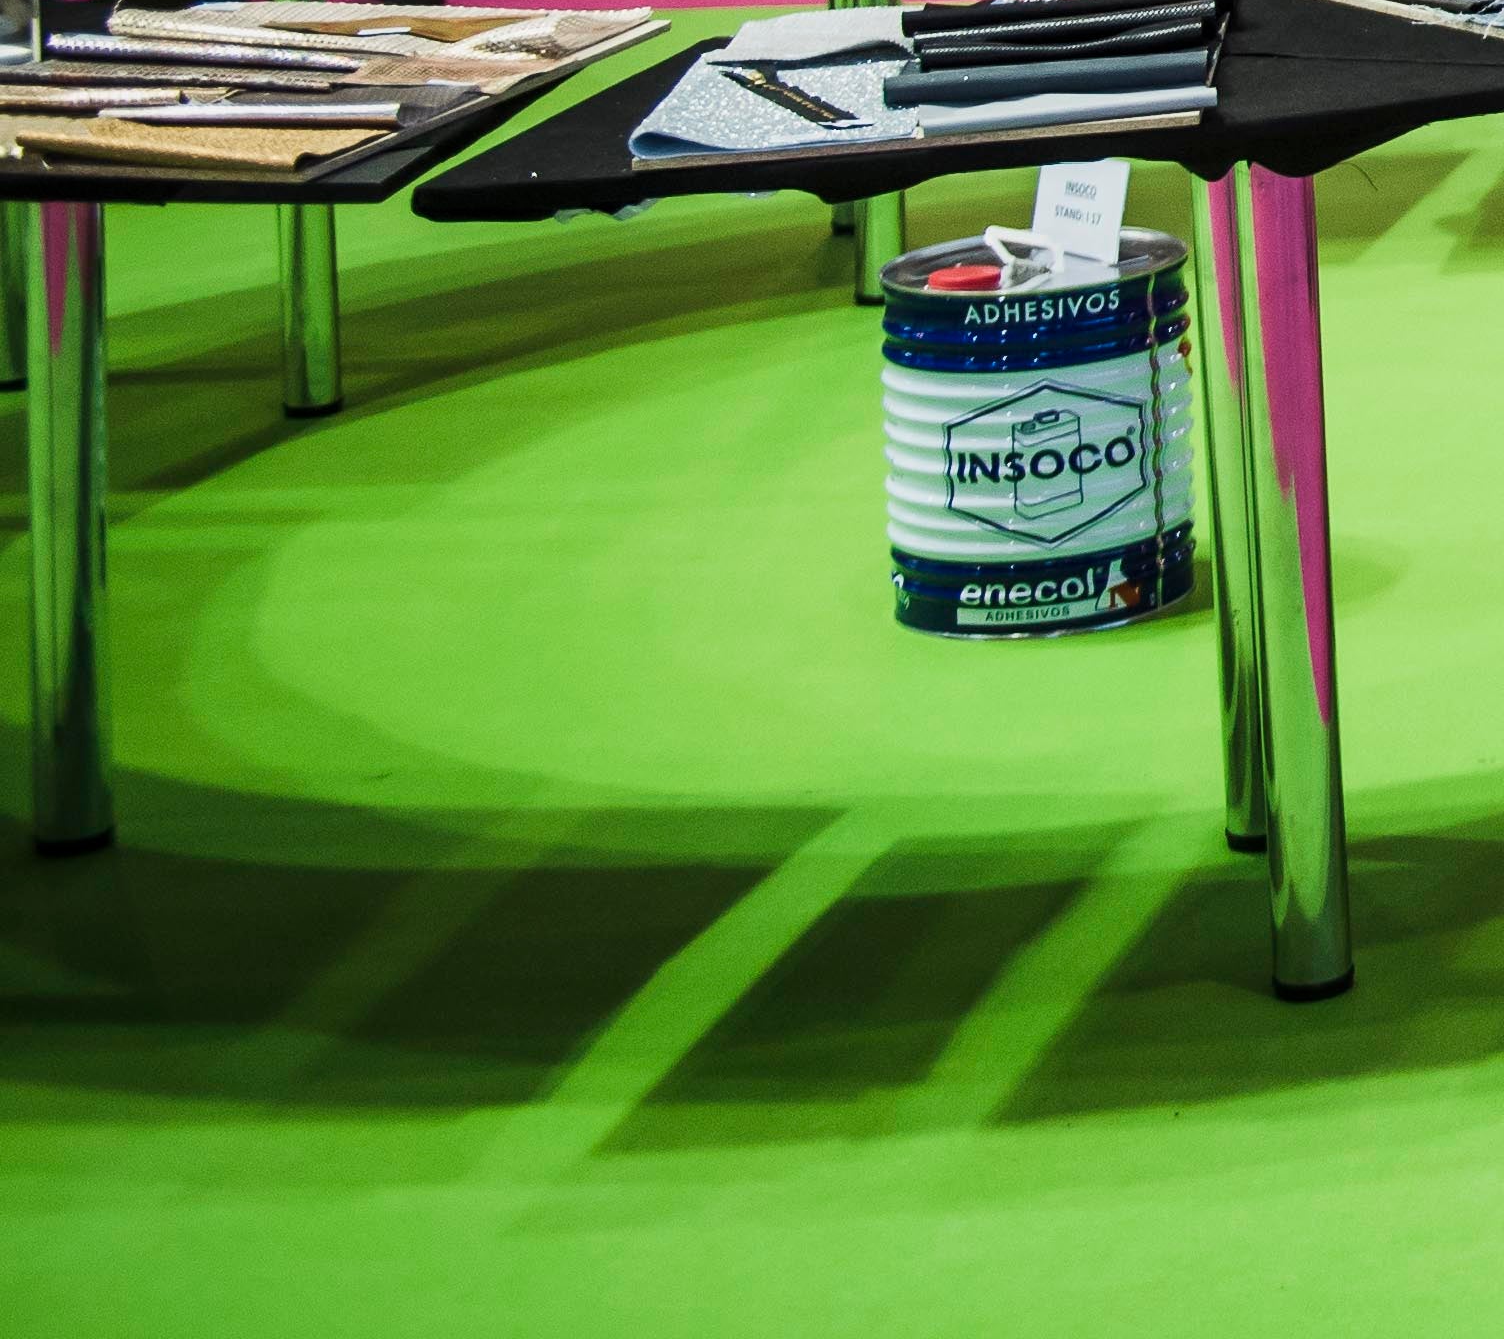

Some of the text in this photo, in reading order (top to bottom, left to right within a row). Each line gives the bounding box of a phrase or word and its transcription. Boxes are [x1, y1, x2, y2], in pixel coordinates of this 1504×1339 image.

[964, 288, 1121, 325] ADHESIVOS
[956, 435, 1137, 484] INSOCO
[959, 567, 1095, 606] enecol
[985, 606, 1070, 622] ADHESIVOS
